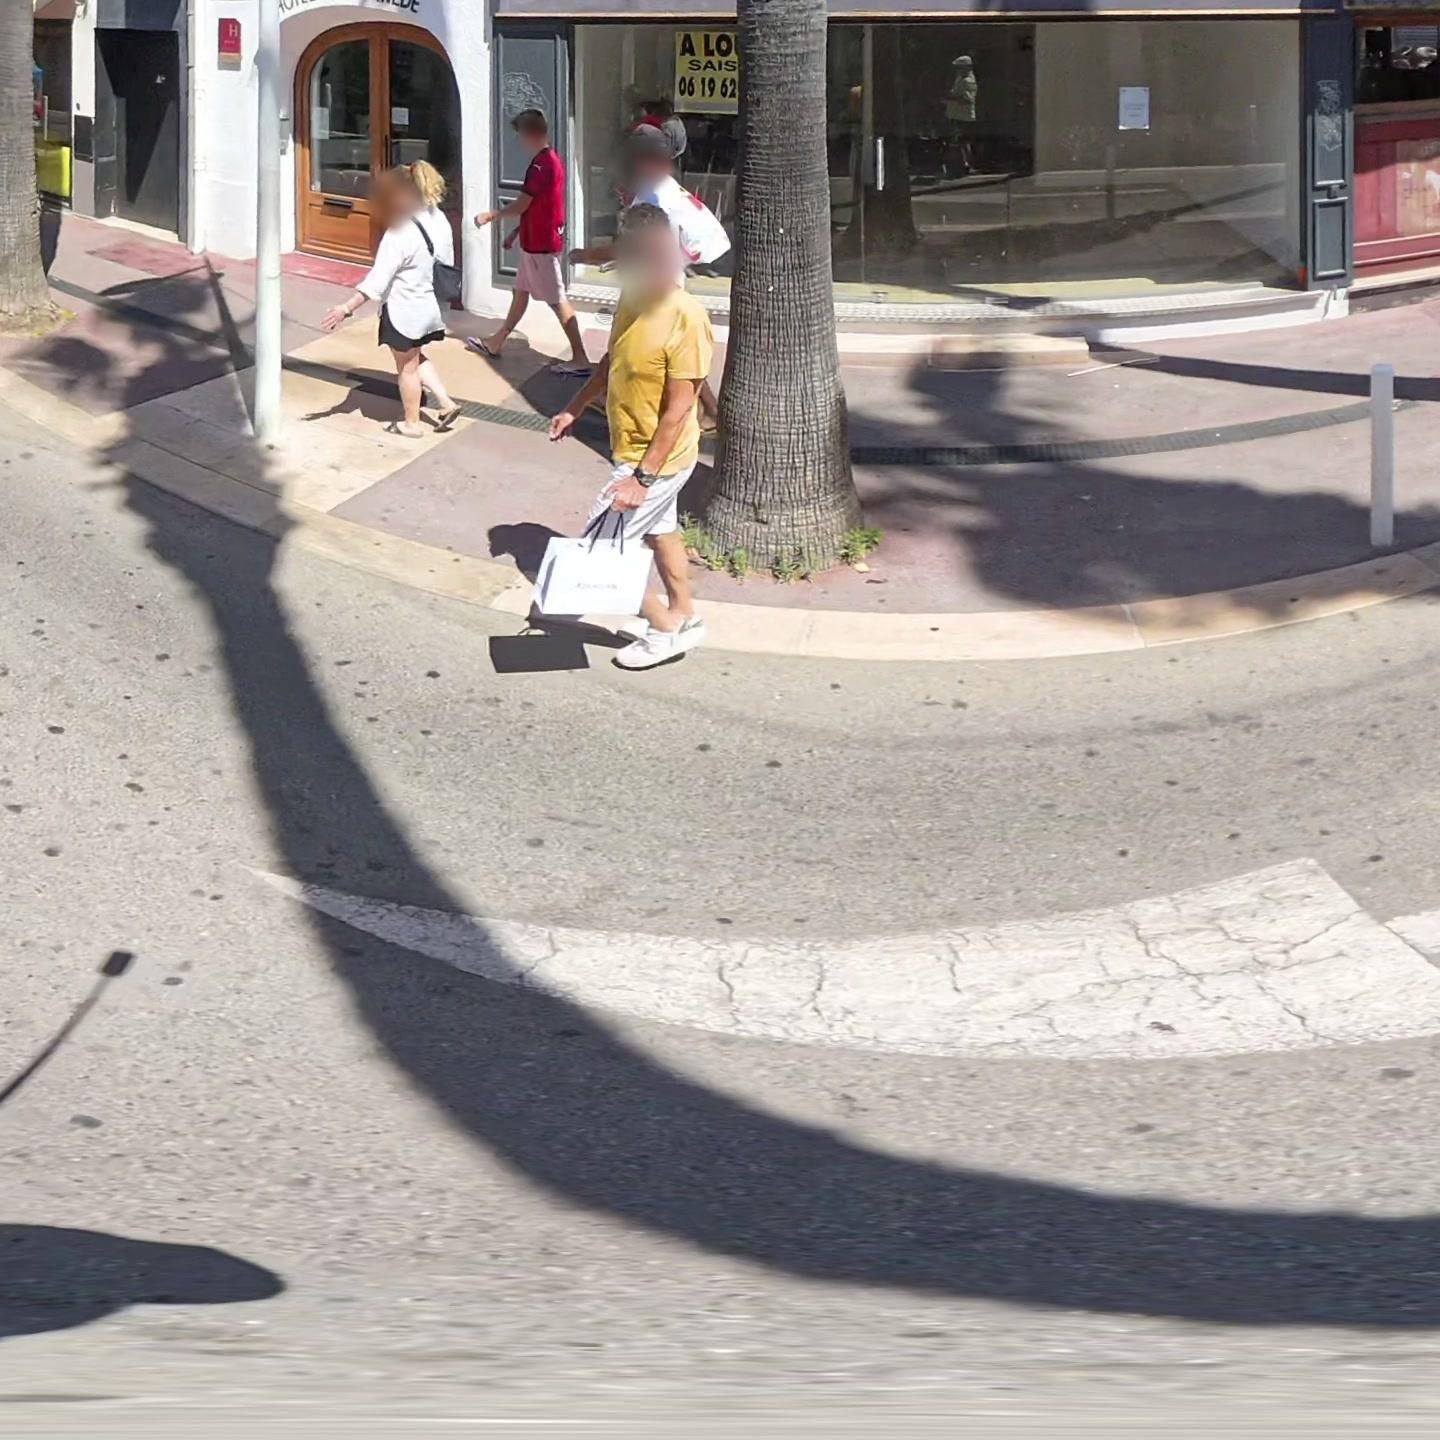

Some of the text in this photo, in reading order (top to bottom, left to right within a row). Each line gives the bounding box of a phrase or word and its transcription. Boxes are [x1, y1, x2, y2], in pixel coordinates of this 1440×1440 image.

[680, 33, 696, 56] A
[679, 76, 695, 97] 06
[701, 76, 716, 98] 19
